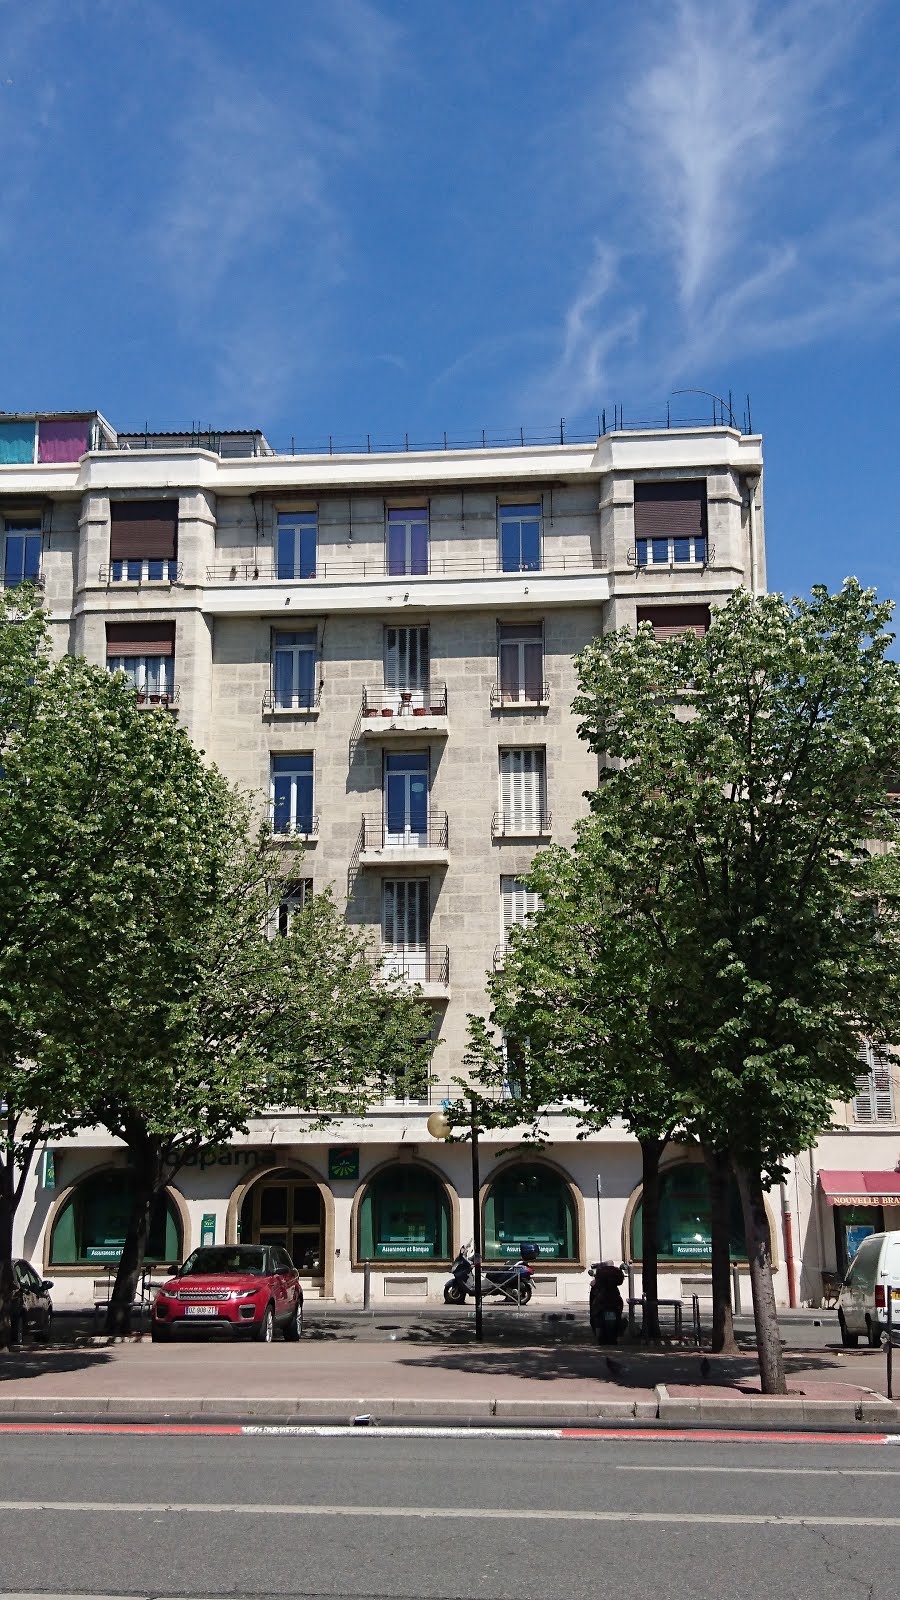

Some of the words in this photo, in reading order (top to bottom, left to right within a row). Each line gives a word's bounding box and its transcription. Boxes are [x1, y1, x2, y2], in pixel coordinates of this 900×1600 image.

[833, 1196, 879, 1205] NOUVELLE
[882, 1196, 900, 1205] BRA
[412, 1246, 430, 1254] Banque
